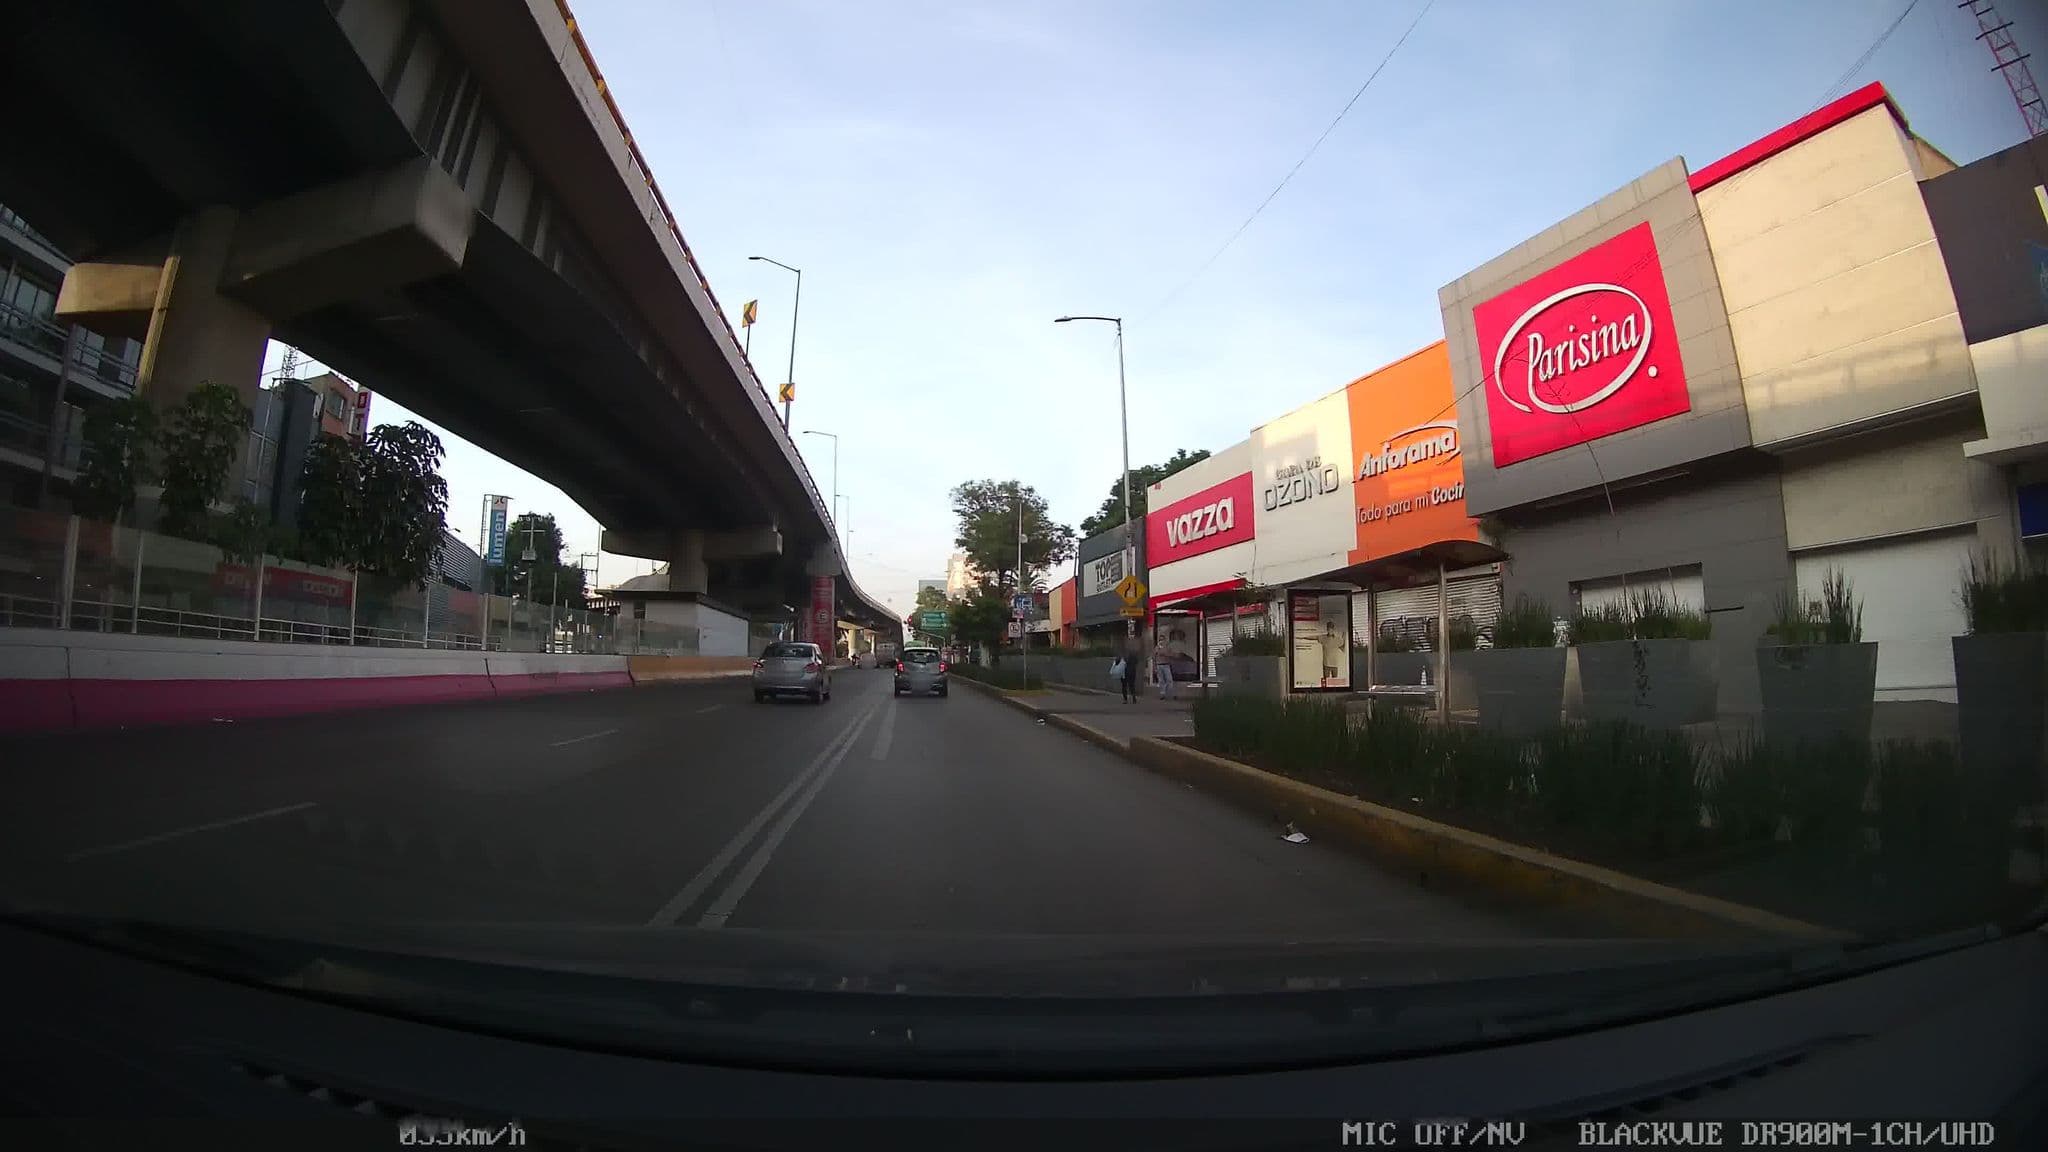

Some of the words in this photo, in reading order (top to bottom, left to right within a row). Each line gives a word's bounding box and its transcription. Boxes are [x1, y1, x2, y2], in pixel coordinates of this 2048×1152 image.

[1527, 312, 1641, 382] Parisina
[1358, 428, 1456, 480] Anforama
[1264, 463, 1339, 512] OZONO
[1357, 503, 1383, 524] Todo
[1385, 498, 1412, 520] para
[1416, 490, 1430, 509] mi
[488, 511, 505, 564] lumen
[1166, 497, 1235, 548] vazza
